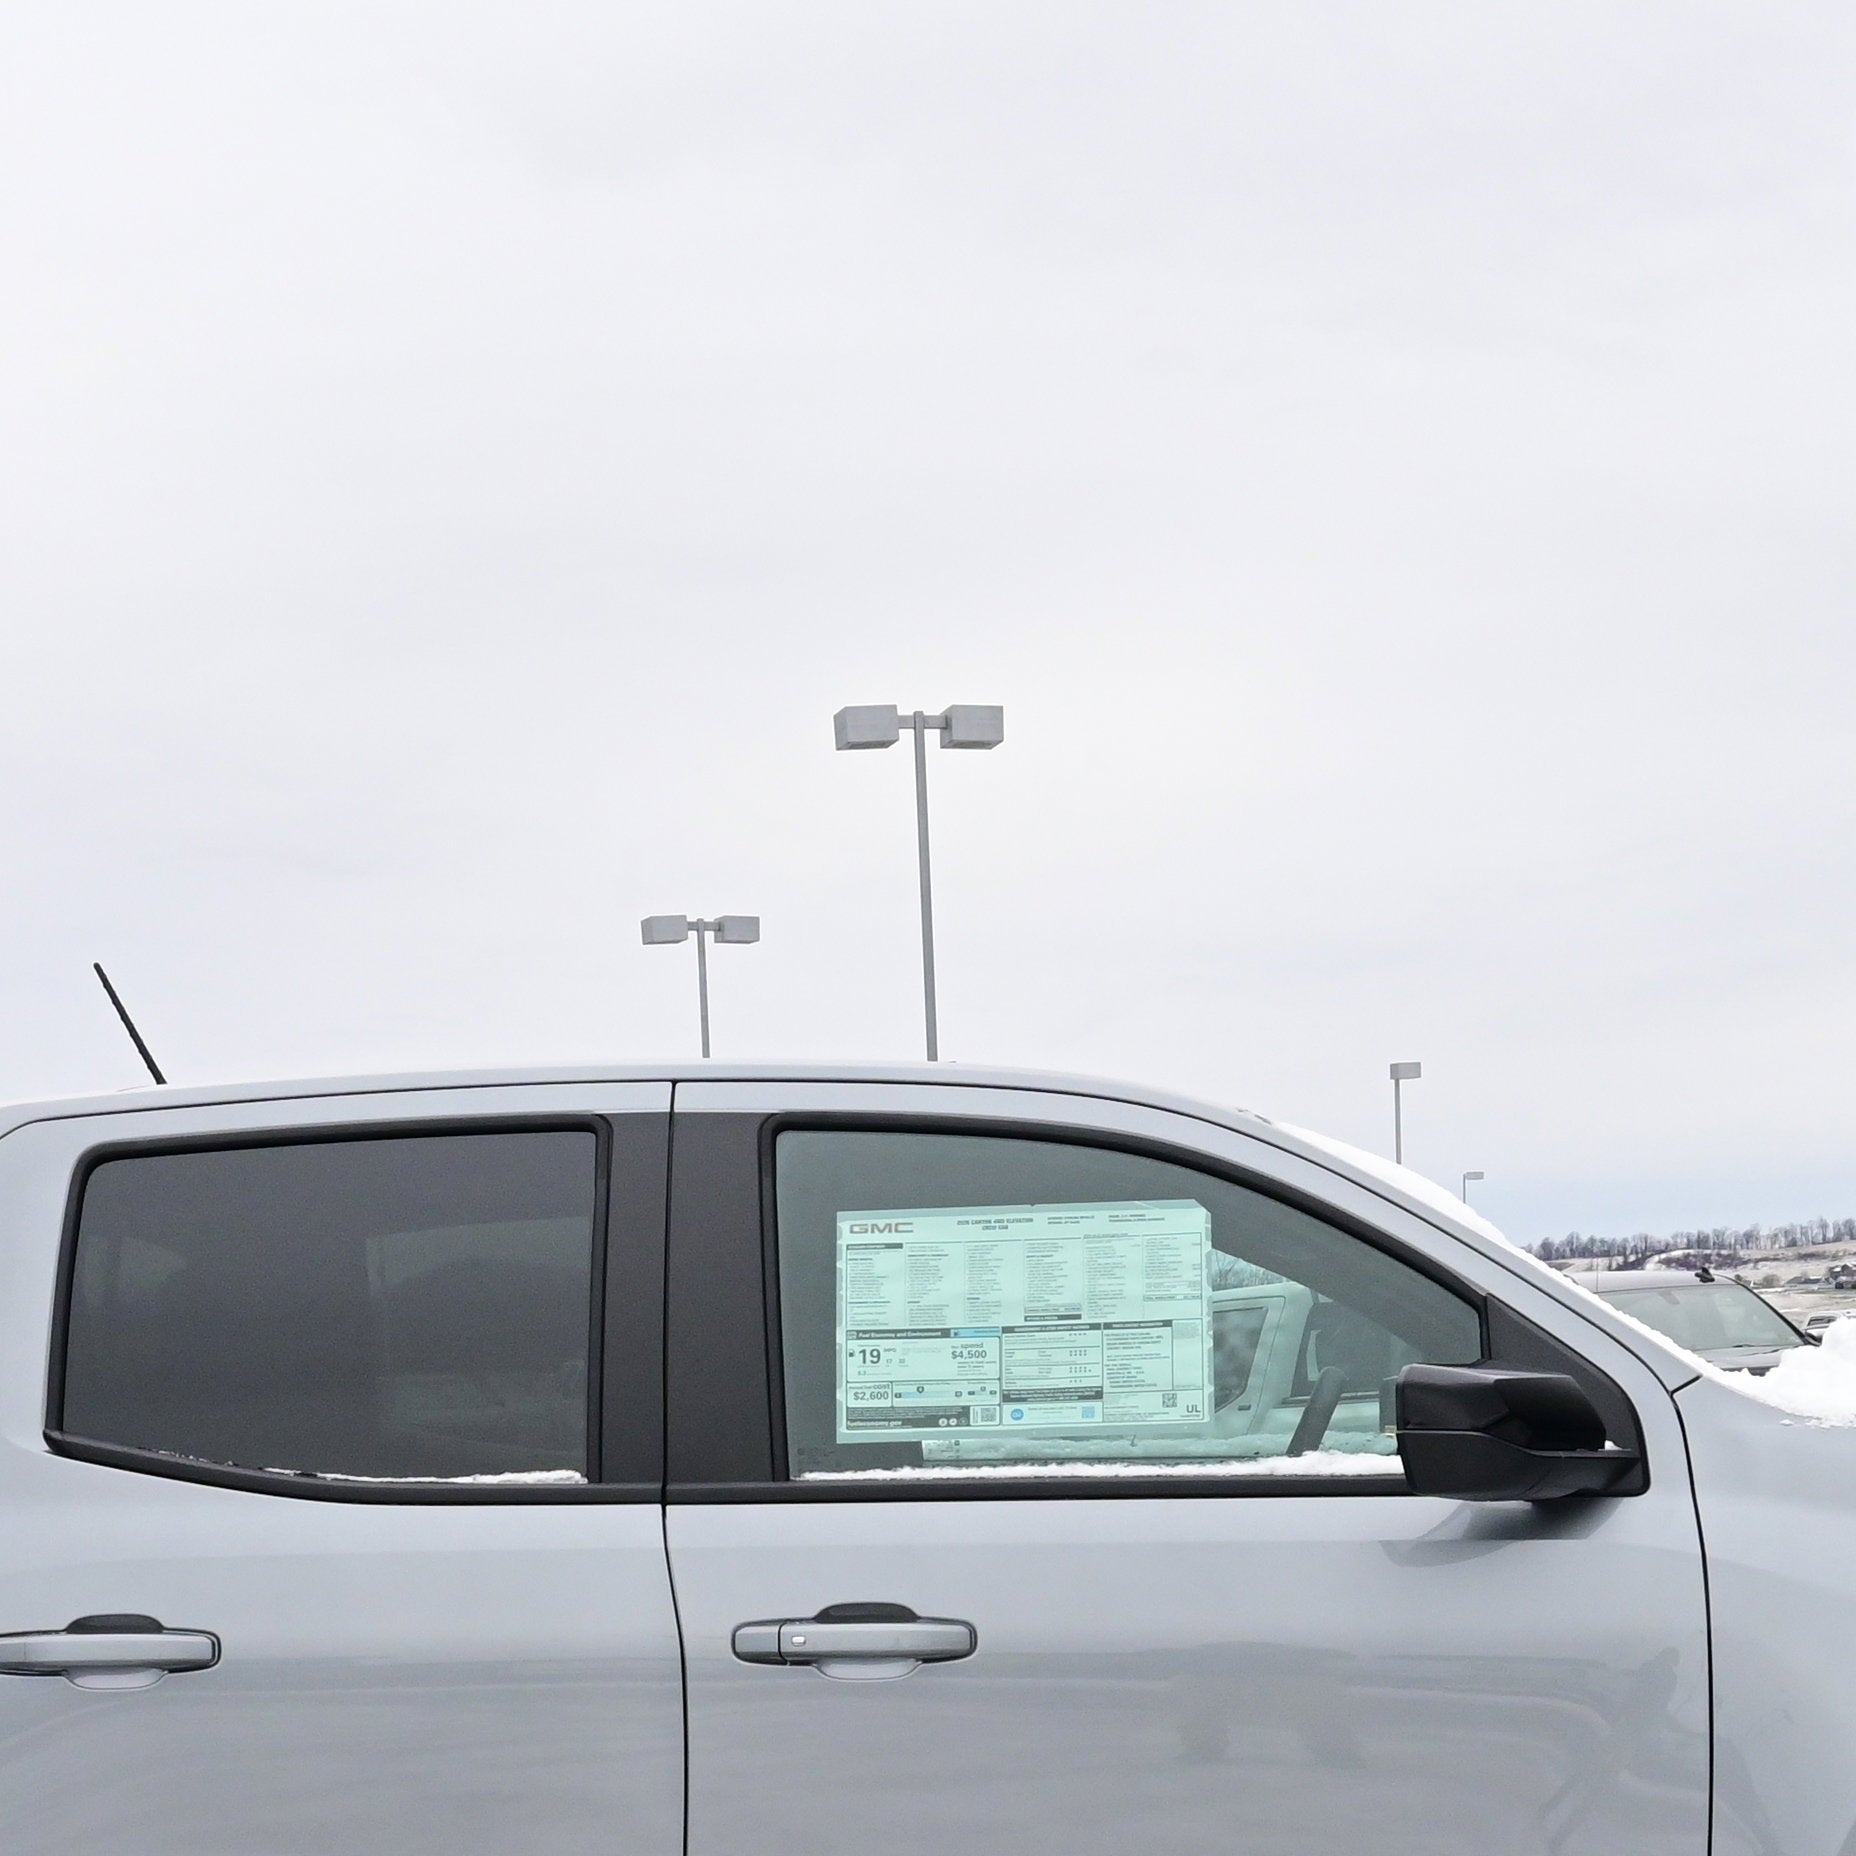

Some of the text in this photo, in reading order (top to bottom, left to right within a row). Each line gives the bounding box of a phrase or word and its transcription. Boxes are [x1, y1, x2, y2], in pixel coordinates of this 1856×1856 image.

[849, 1222, 914, 1234] GMC
[858, 1348, 881, 1365] 19
[951, 1350, 987, 1360] $4,500
[853, 1391, 889, 1401] $2,600
[1186, 1404, 1201, 1413] UL
